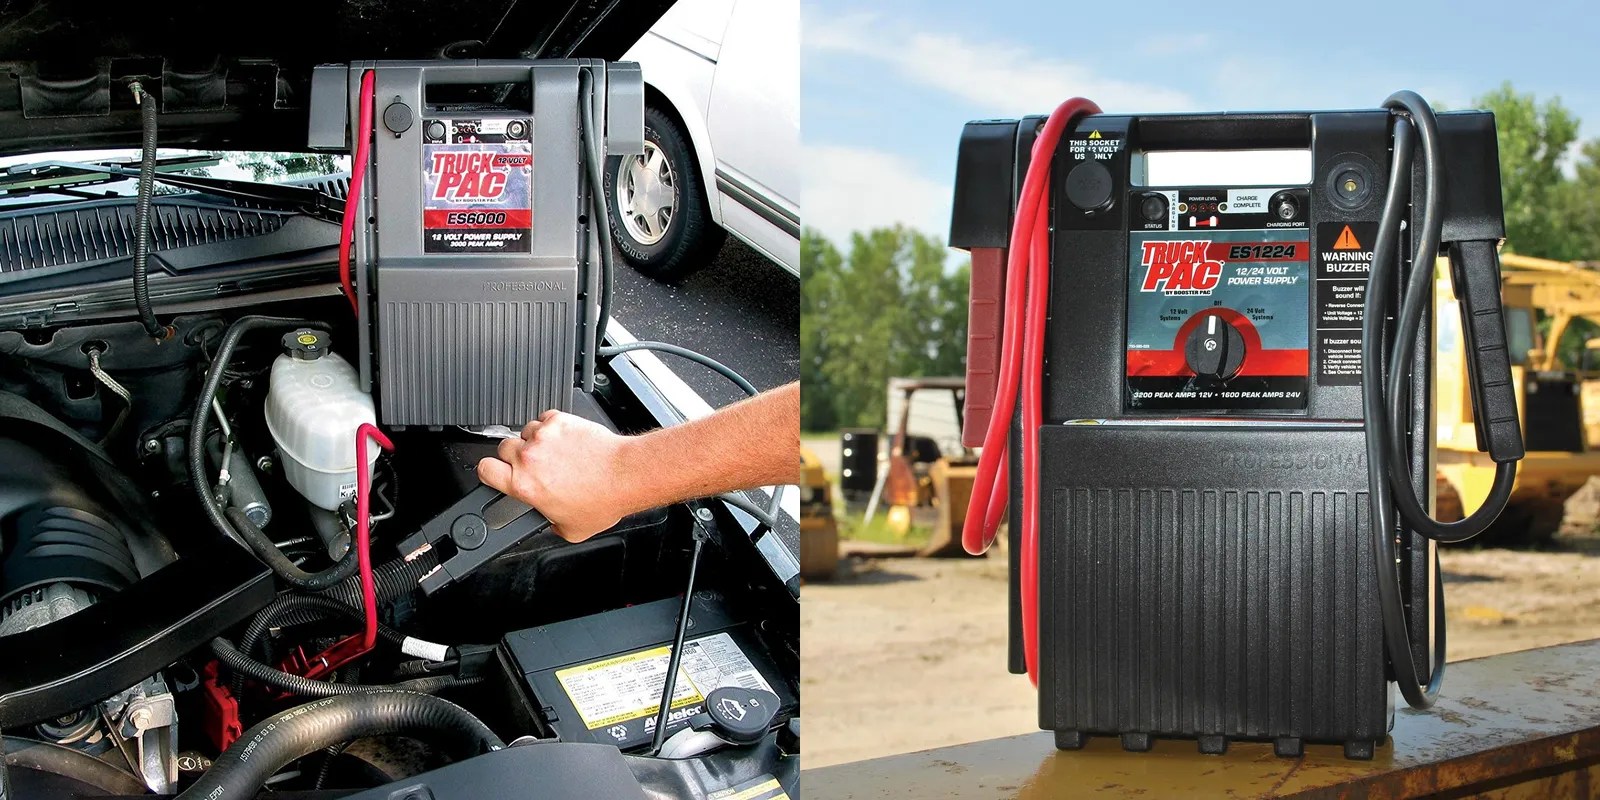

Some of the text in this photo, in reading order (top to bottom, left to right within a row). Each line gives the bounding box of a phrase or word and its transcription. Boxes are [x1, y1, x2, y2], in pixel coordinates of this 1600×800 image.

[433, 152, 494, 174] TRUCK
[435, 172, 506, 198] PAC
[447, 212, 507, 225] ES6000
[432, 233, 522, 241] 12 VOLT POWER SUPPLY
[1143, 241, 1296, 264] TRUCK ES1224
[1321, 251, 1374, 262] WARNING
[1235, 266, 1289, 276] 12/24 VOLT
[1326, 263, 1370, 273] BUZZER
[1143, 261, 1222, 290] PAC
[1227, 276, 1299, 285] POWER SUPPLY
[482, 281, 567, 291] PROFESSIONAL
[1134, 391, 1153, 399] 3200
[1154, 391, 1174, 399] PEAK
[1175, 391, 1197, 399] AMPS
[1198, 391, 1213, 399] 12V
[1221, 452, 1367, 470] PROFESSIONAL
